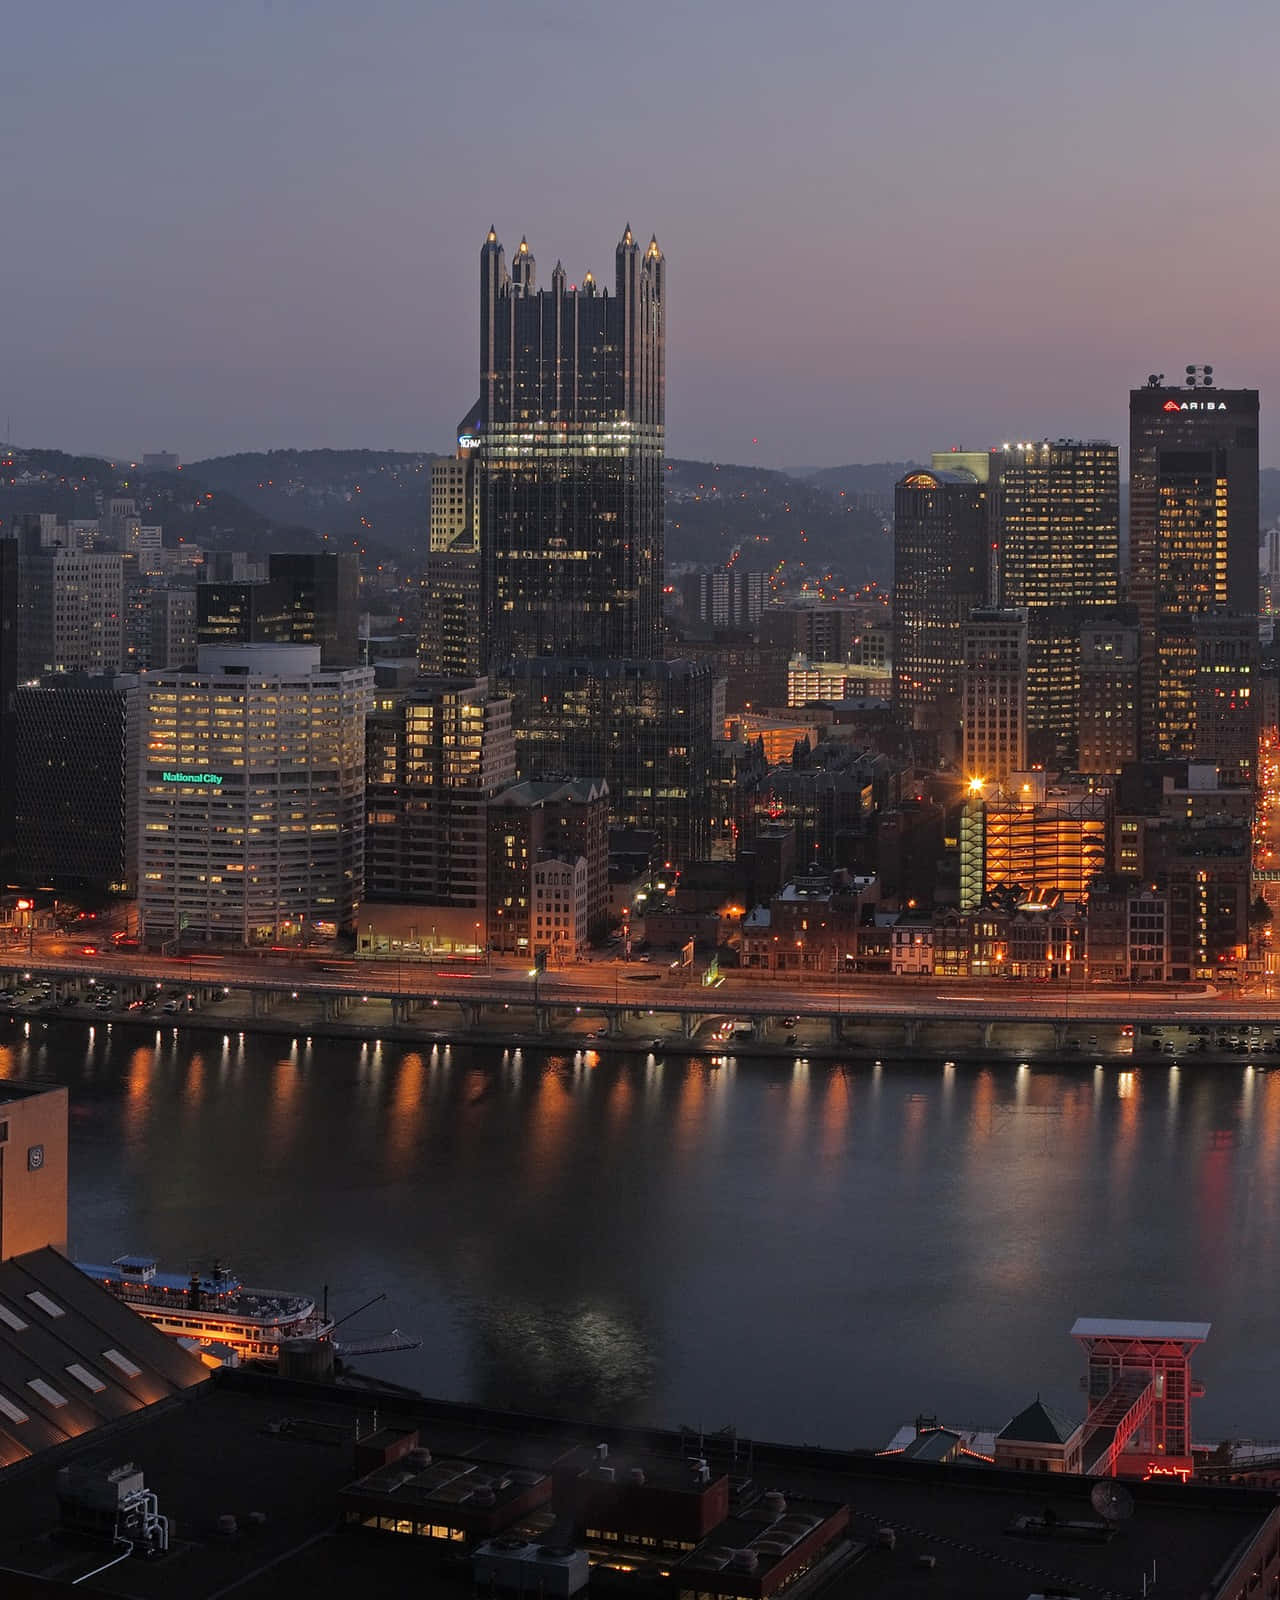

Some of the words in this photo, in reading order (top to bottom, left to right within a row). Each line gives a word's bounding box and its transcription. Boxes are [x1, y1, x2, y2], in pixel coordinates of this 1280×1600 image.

[1180, 402, 1227, 410] ARIBA
[162, 772, 203, 783] National
[203, 774, 223, 785] City
